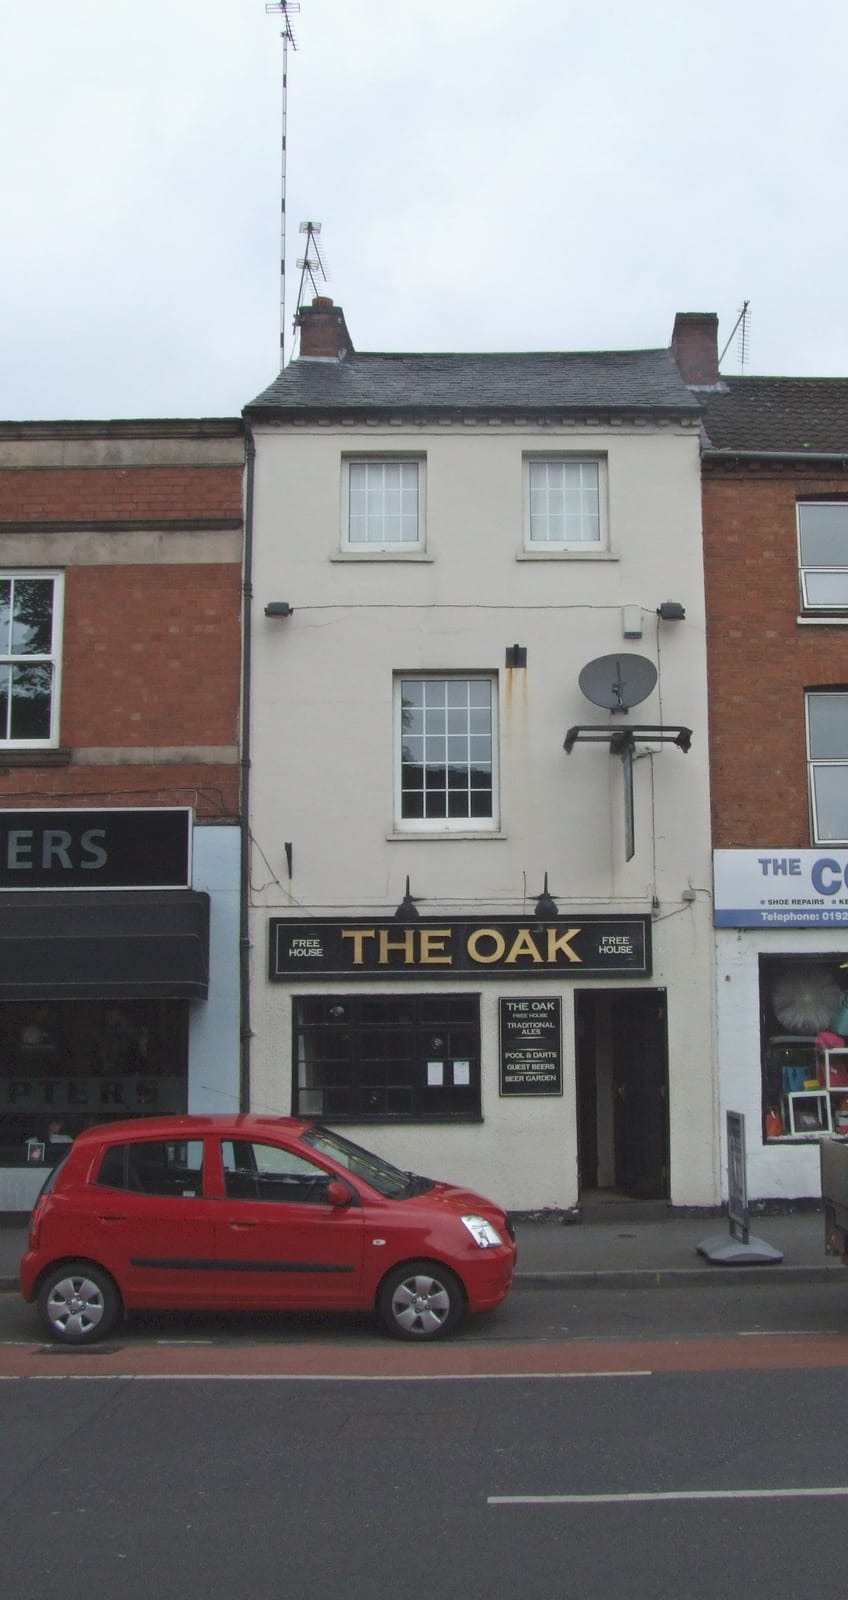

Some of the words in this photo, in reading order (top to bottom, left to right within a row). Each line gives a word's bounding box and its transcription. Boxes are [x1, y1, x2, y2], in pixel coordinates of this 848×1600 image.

[7, 829, 108, 869] ERS
[758, 858, 802, 876] THE
[811, 858, 848, 895] C
[760, 911, 819, 922] Telephone:
[822, 911, 848, 921] 0192
[292, 939, 320, 948] FREE
[602, 936, 630, 945] FREE
[341, 928, 452, 965] THE
[466, 928, 583, 964] OAK
[598, 945, 633, 954] HOUSE
[288, 947, 323, 957] HOUSE
[506, 1002, 528, 1010] THE
[531, 1002, 555, 1011] OAK
